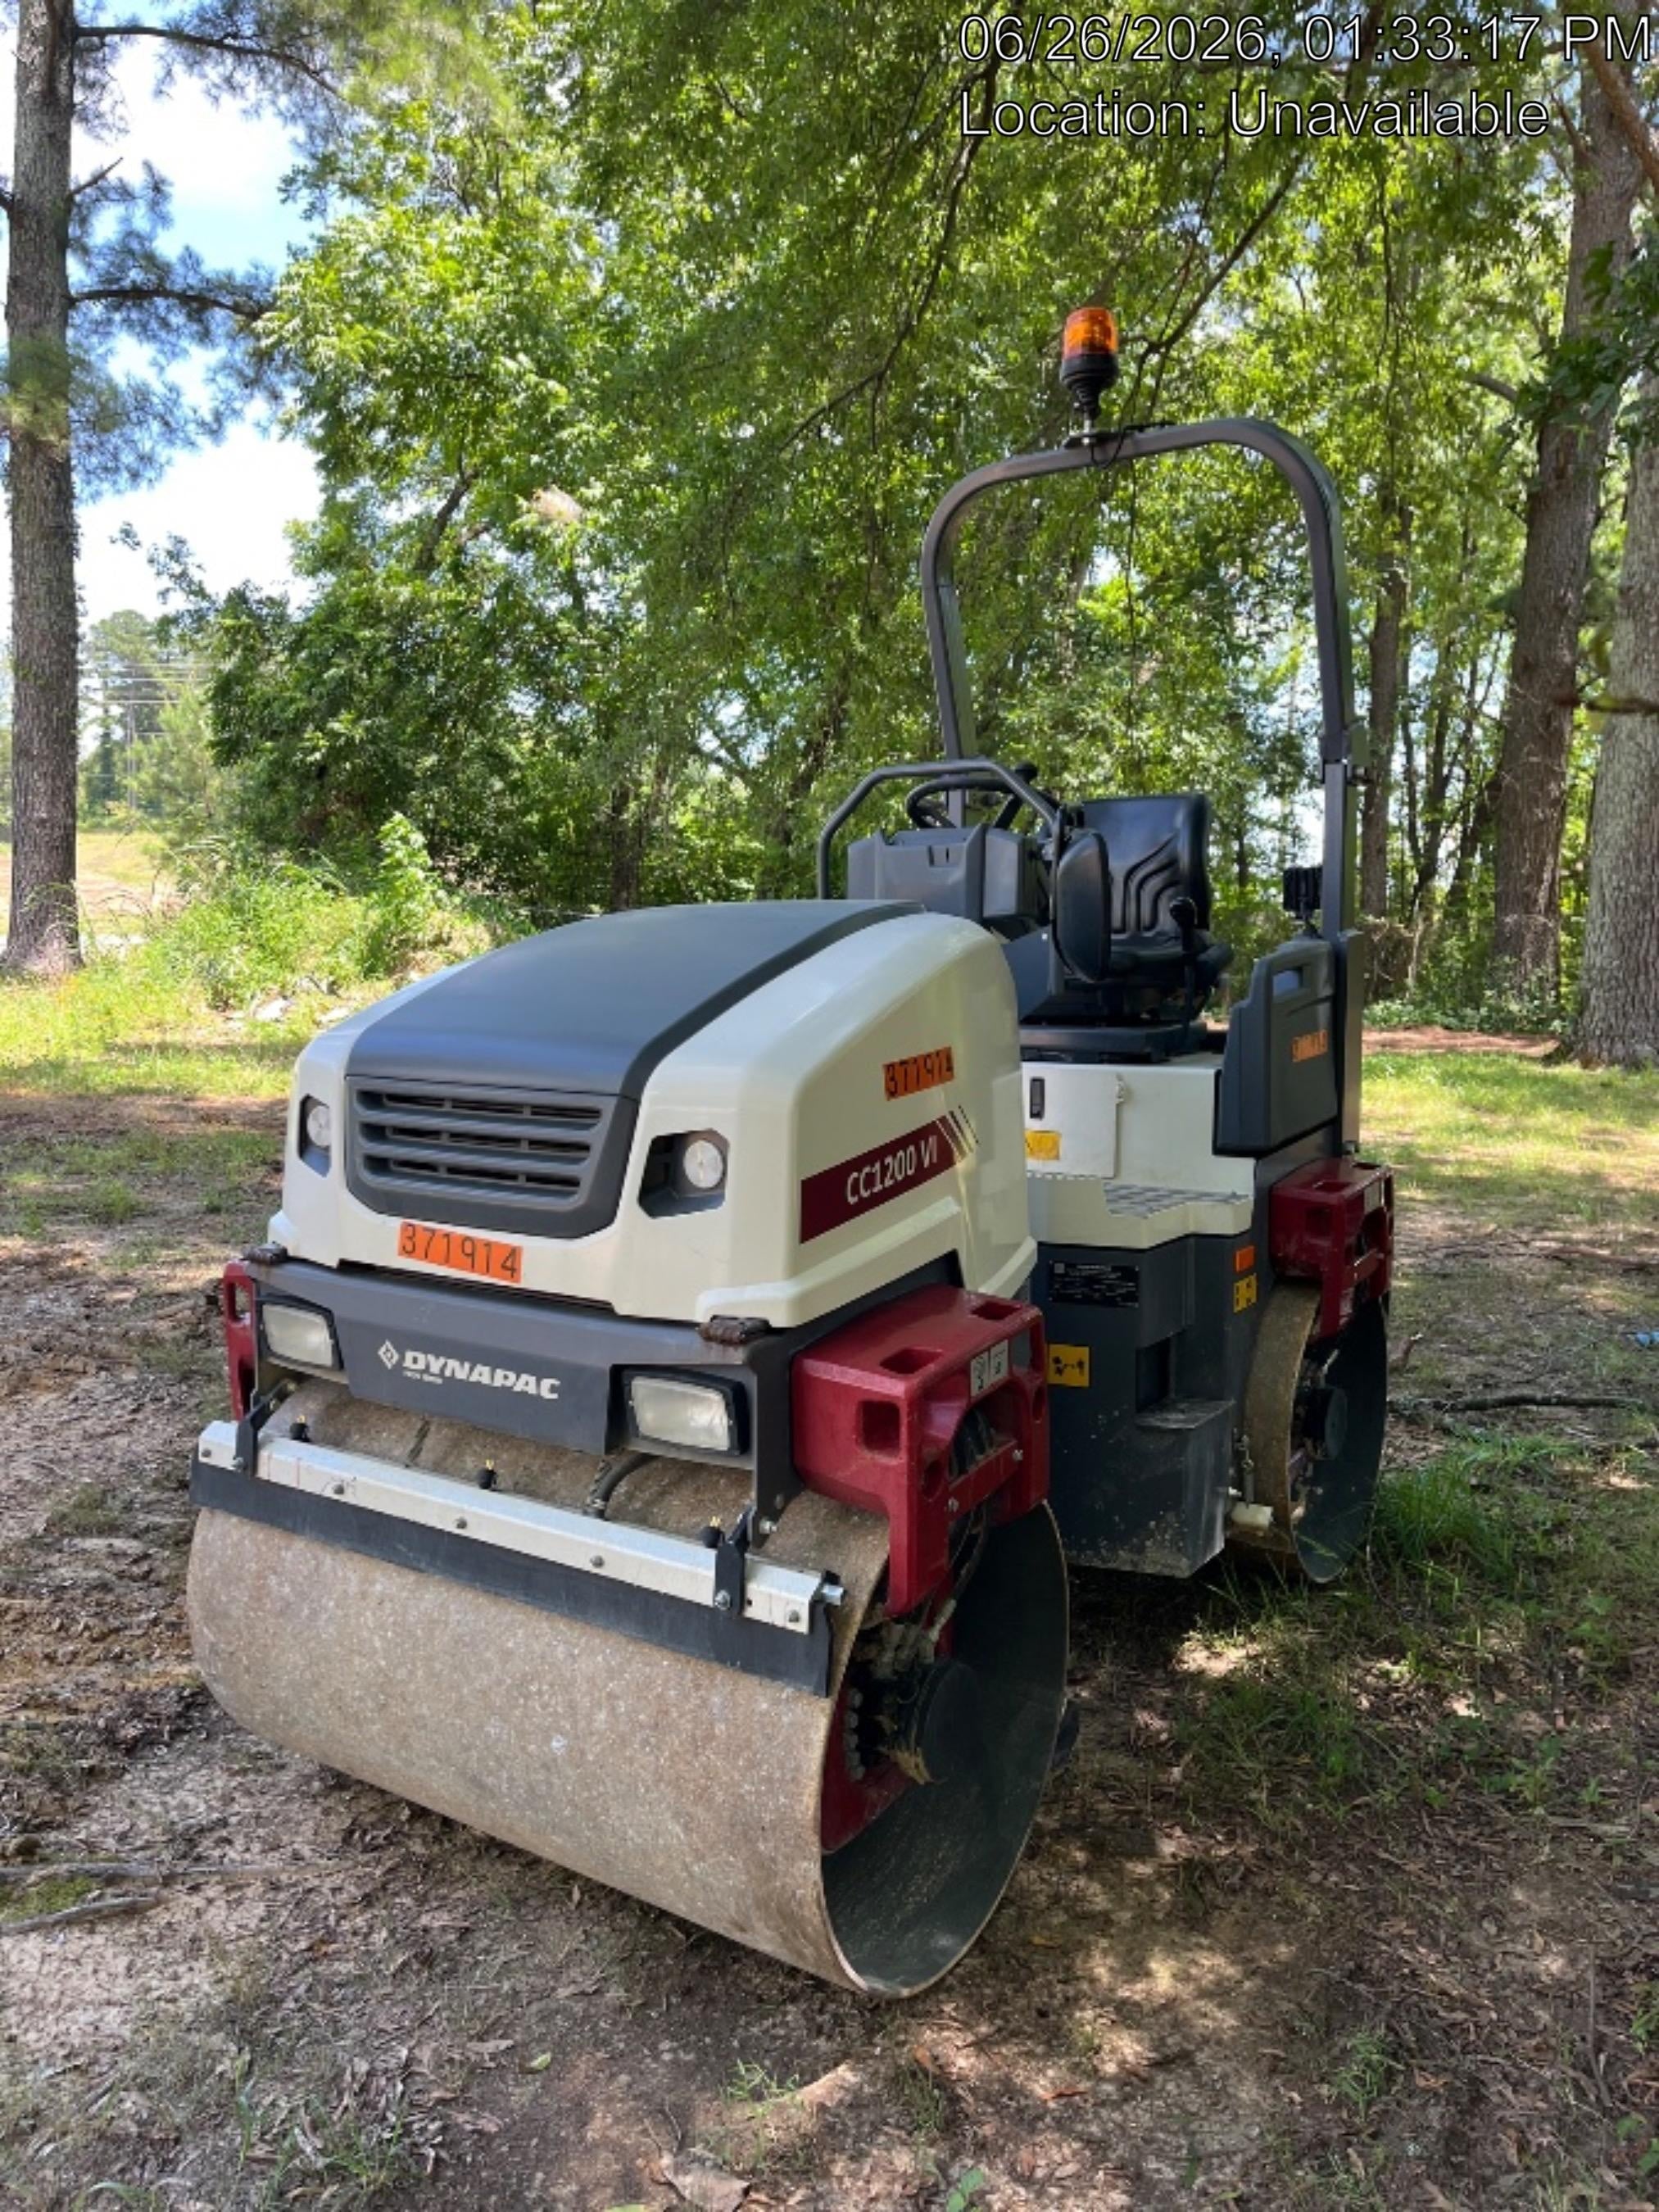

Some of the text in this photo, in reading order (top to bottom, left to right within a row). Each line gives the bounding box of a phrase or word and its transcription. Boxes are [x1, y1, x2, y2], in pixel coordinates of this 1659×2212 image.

[846, 1145, 916, 1205] CC1200
[401, 1223, 517, 1279] 371914
[402, 1349, 560, 1399] DYNAPAC
